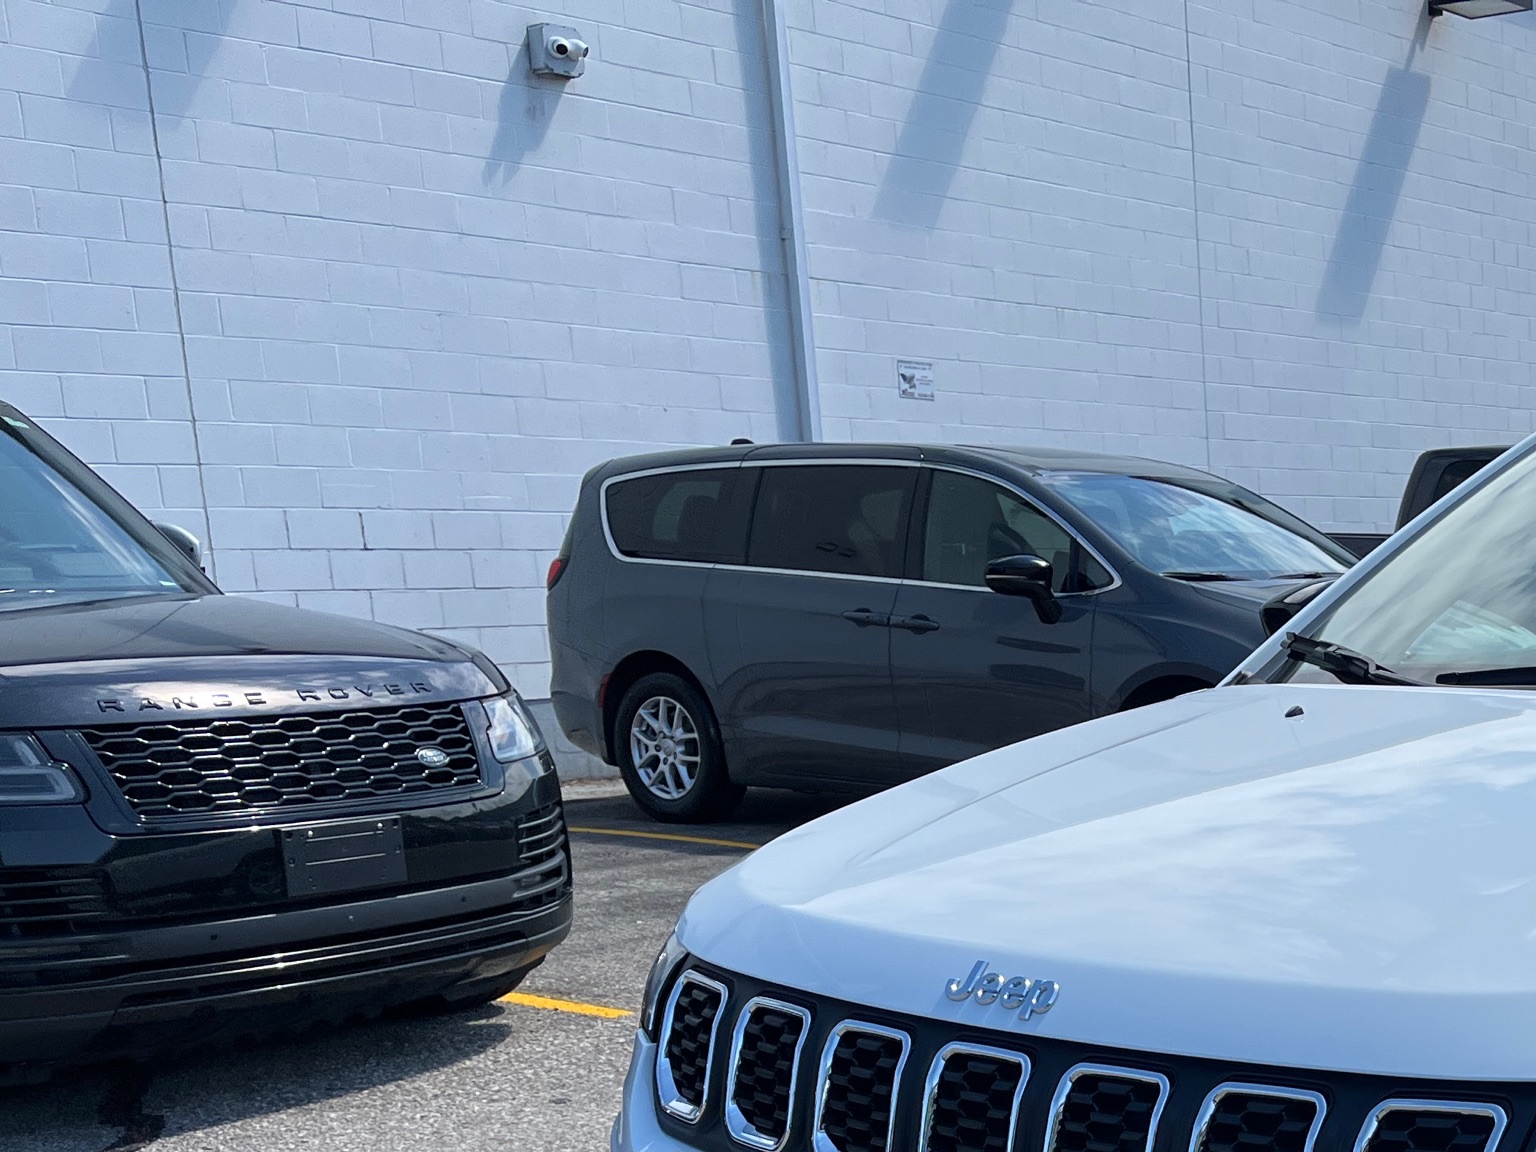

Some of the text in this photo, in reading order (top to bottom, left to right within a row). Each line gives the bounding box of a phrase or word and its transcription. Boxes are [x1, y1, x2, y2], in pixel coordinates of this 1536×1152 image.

[97, 681, 432, 713] RANGE ROVER
[945, 960, 1059, 1021] Jeep
